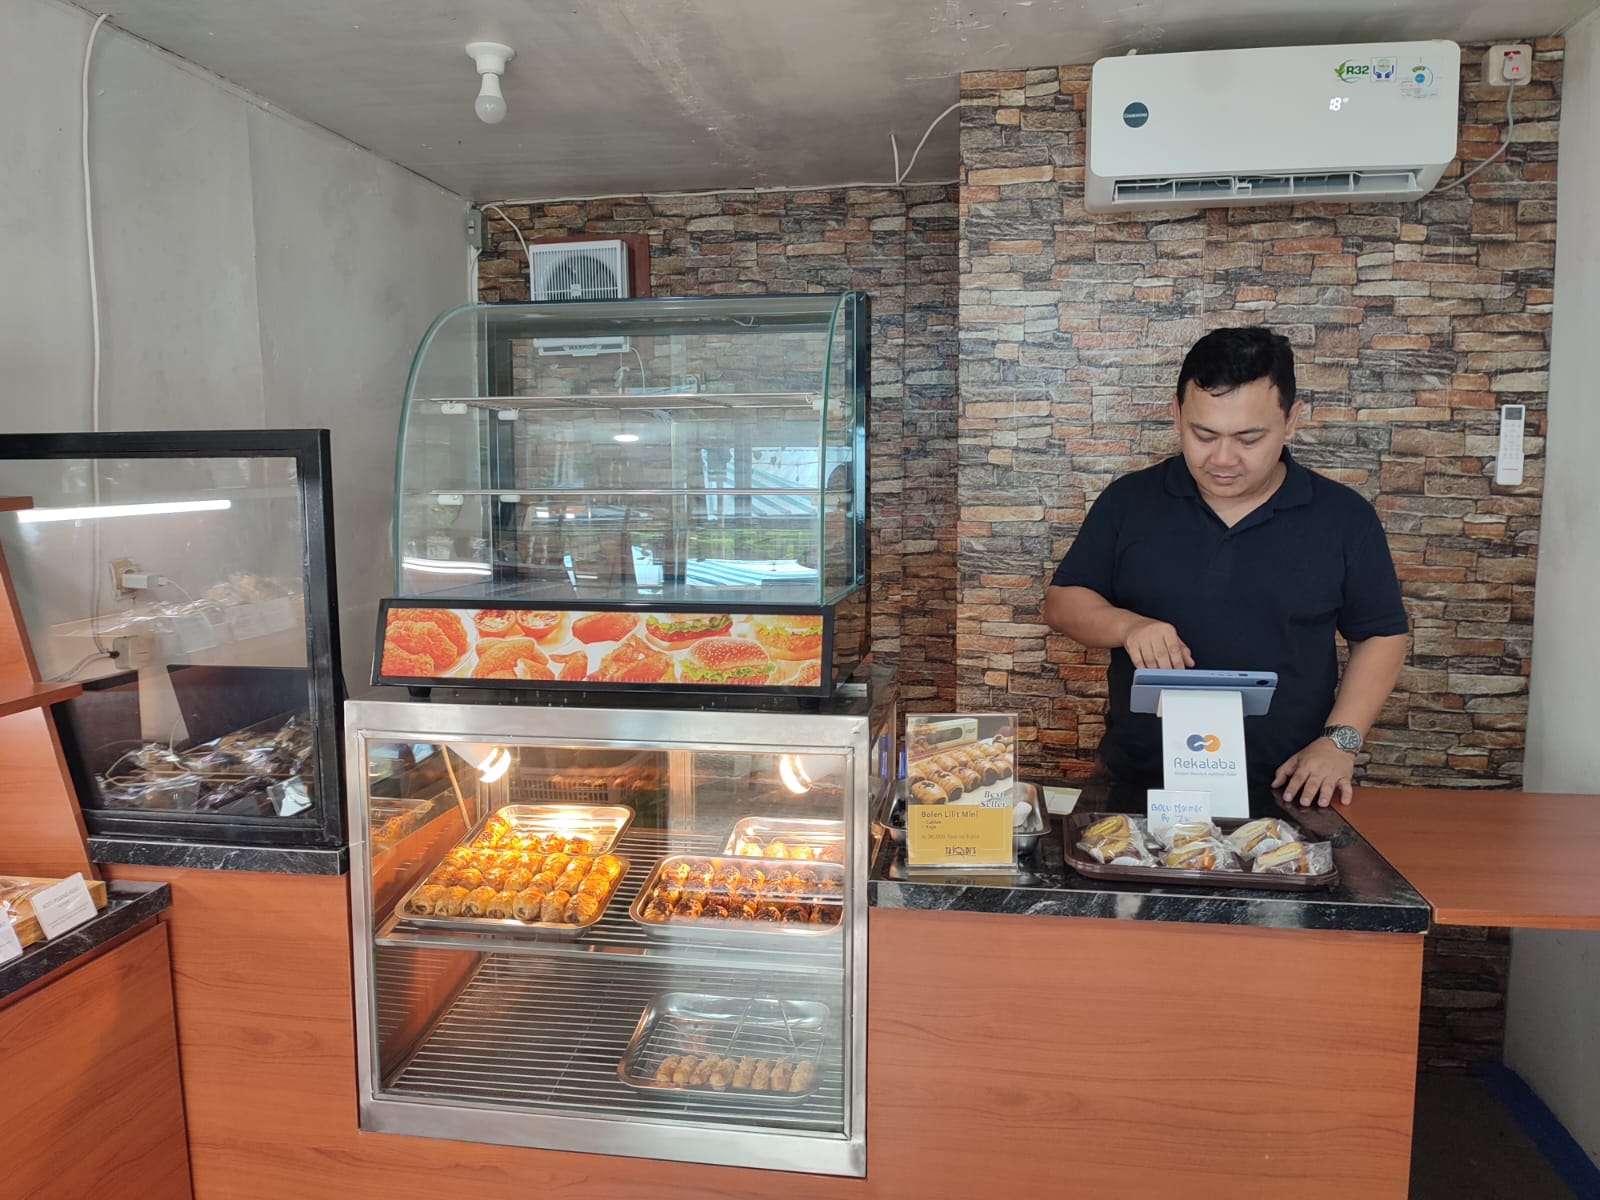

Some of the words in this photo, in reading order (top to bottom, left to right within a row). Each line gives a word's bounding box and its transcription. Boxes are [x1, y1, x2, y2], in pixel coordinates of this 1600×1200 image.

[1346, 65, 1369, 75] R32
[1329, 97, 1342, 111] 18
[1174, 757, 1236, 770] Rekalaba
[984, 791, 1004, 799] Best
[981, 799, 1005, 808] Seller
[921, 810, 942, 818] Bolen
[961, 810, 979, 818] Mini
